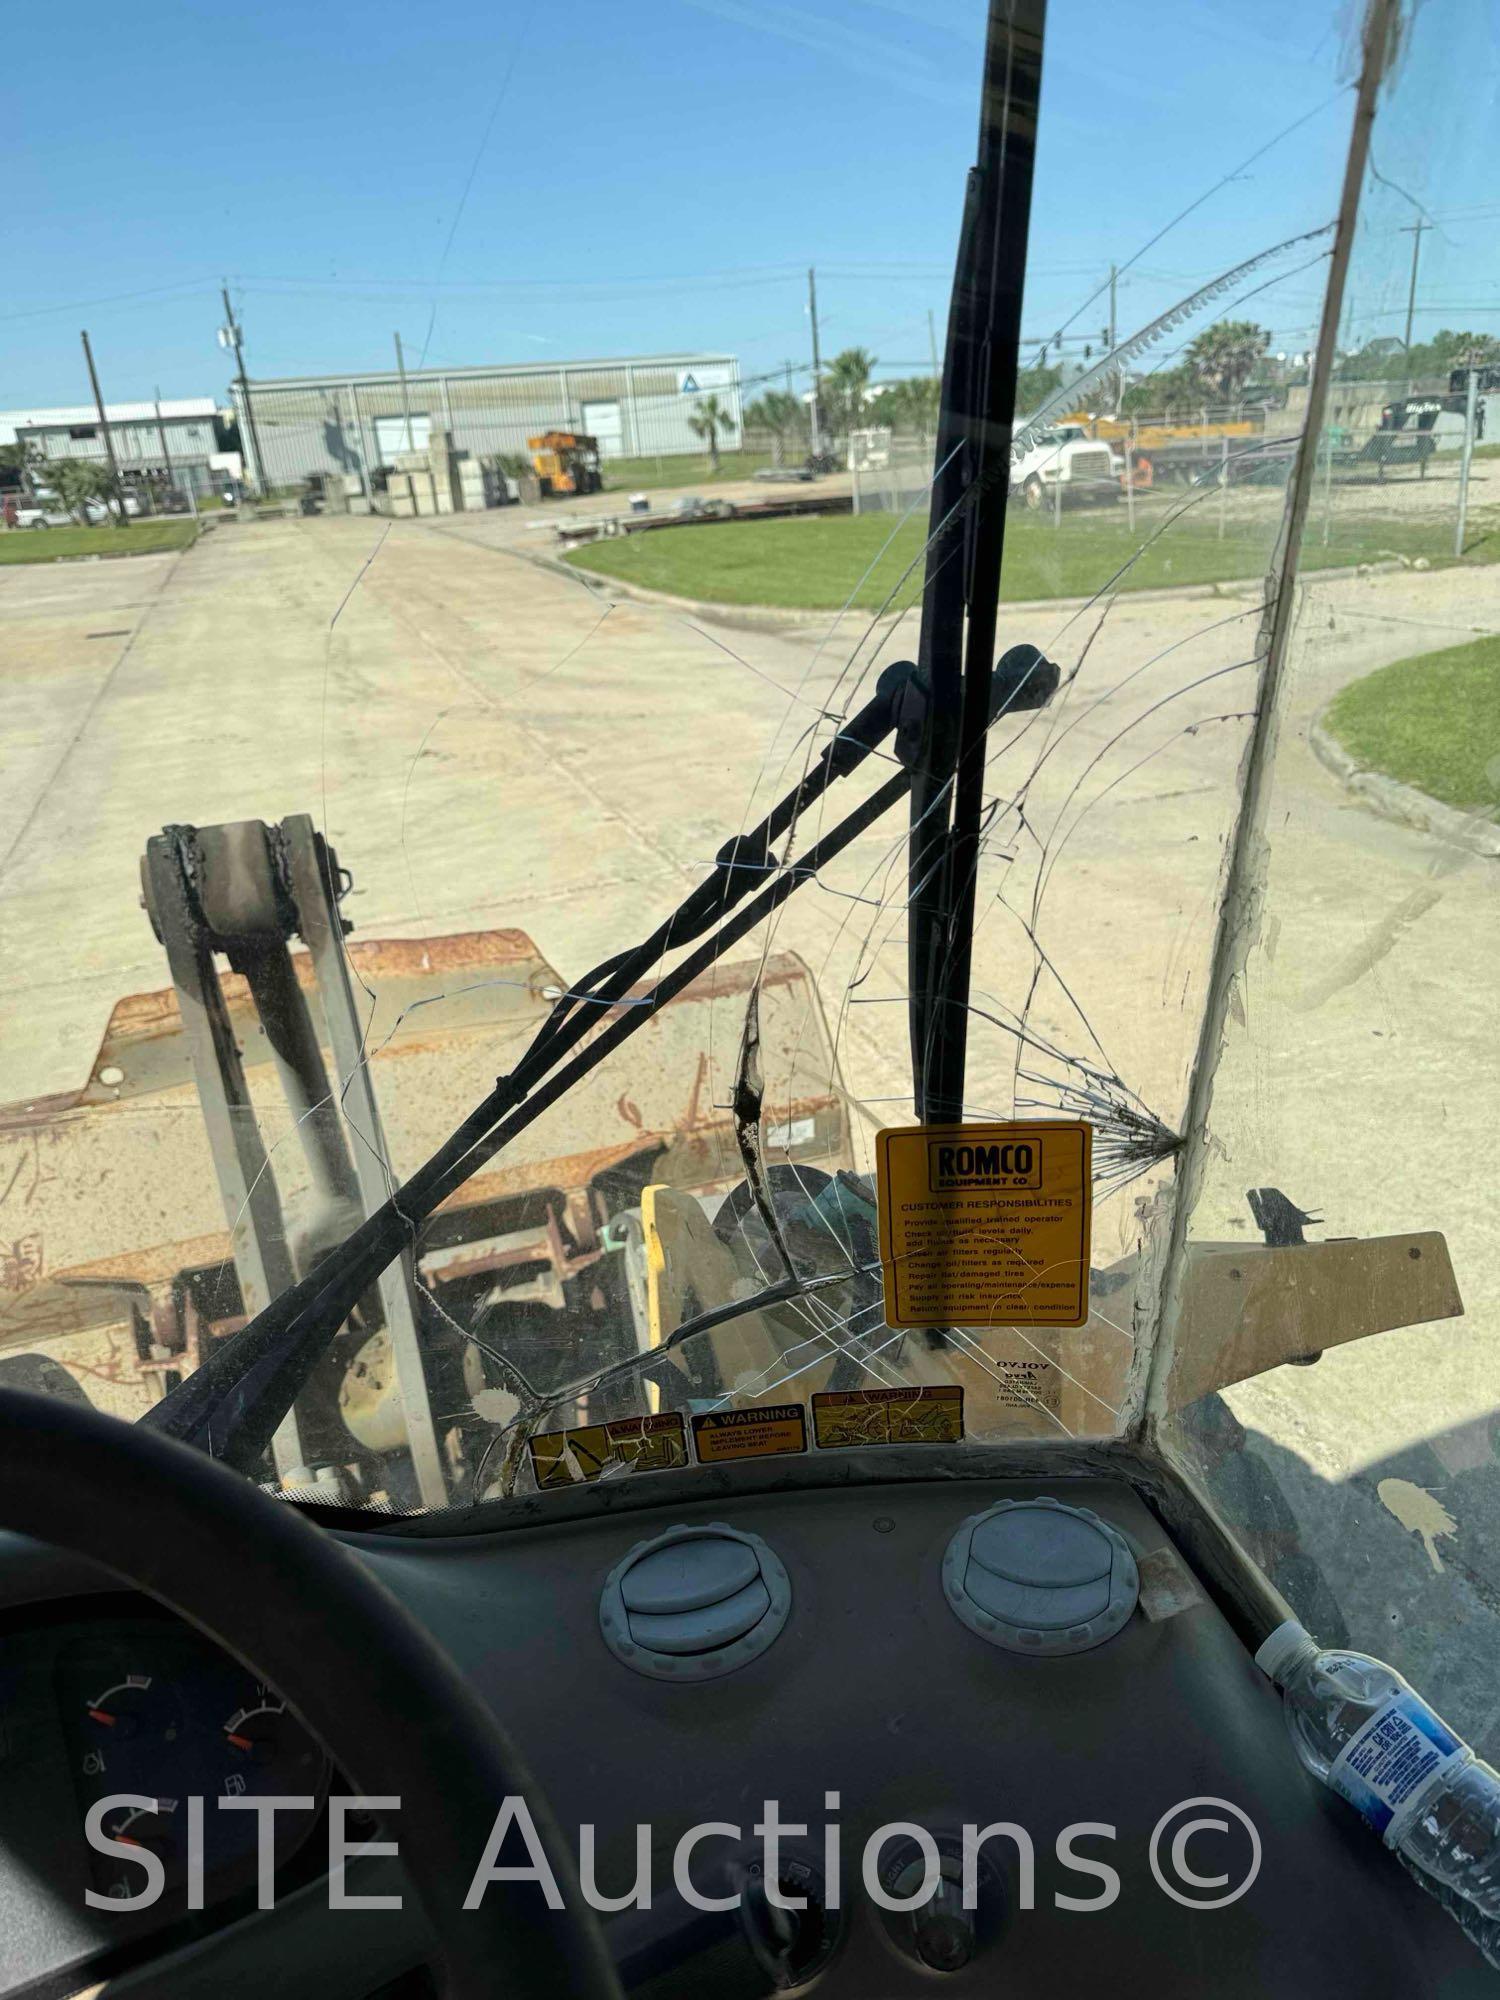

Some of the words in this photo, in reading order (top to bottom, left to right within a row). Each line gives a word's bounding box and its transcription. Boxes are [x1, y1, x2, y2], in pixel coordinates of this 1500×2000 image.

[939, 1145, 1033, 1176] ROMCO
[939, 1177, 1008, 1187] EQUIPMENT
[901, 1202, 964, 1212] CUSTOMER
[967, 1199, 1072, 1209] RESPONSIBILITIES
[904, 1219, 938, 1227] Provide
[1024, 1215, 1063, 1224] operator
[978, 1227, 1005, 1235] levels
[906, 1239, 925, 1247] add
[973, 1236, 1020, 1246] necessary
[983, 1247, 1023, 1257] regularly
[908, 1261, 941, 1270] Change
[908, 1272, 937, 1280] Repair
[909, 1283, 924, 1292] Pay
[909, 1294, 939, 1303] Supply
[910, 1305, 939, 1313] Return
[943, 1303, 989, 1313] equipment
[1033, 1303, 1075, 1311] condition
[867, 1390, 933, 1402] WARNING
[720, 1407, 800, 1426] WARNING
[709, 1430, 742, 1439] ALWAYS
[743, 1427, 774, 1435] LOWER
[710, 1436, 757, 1445] IMPLEMENT
[758, 1431, 792, 1440] BEFORE
[711, 1443, 746, 1452] LEAVING
[747, 1440, 768, 1448] SEAT
[1371, 1731, 1386, 1746] CA
[1379, 1720, 1397, 1738] CRV
